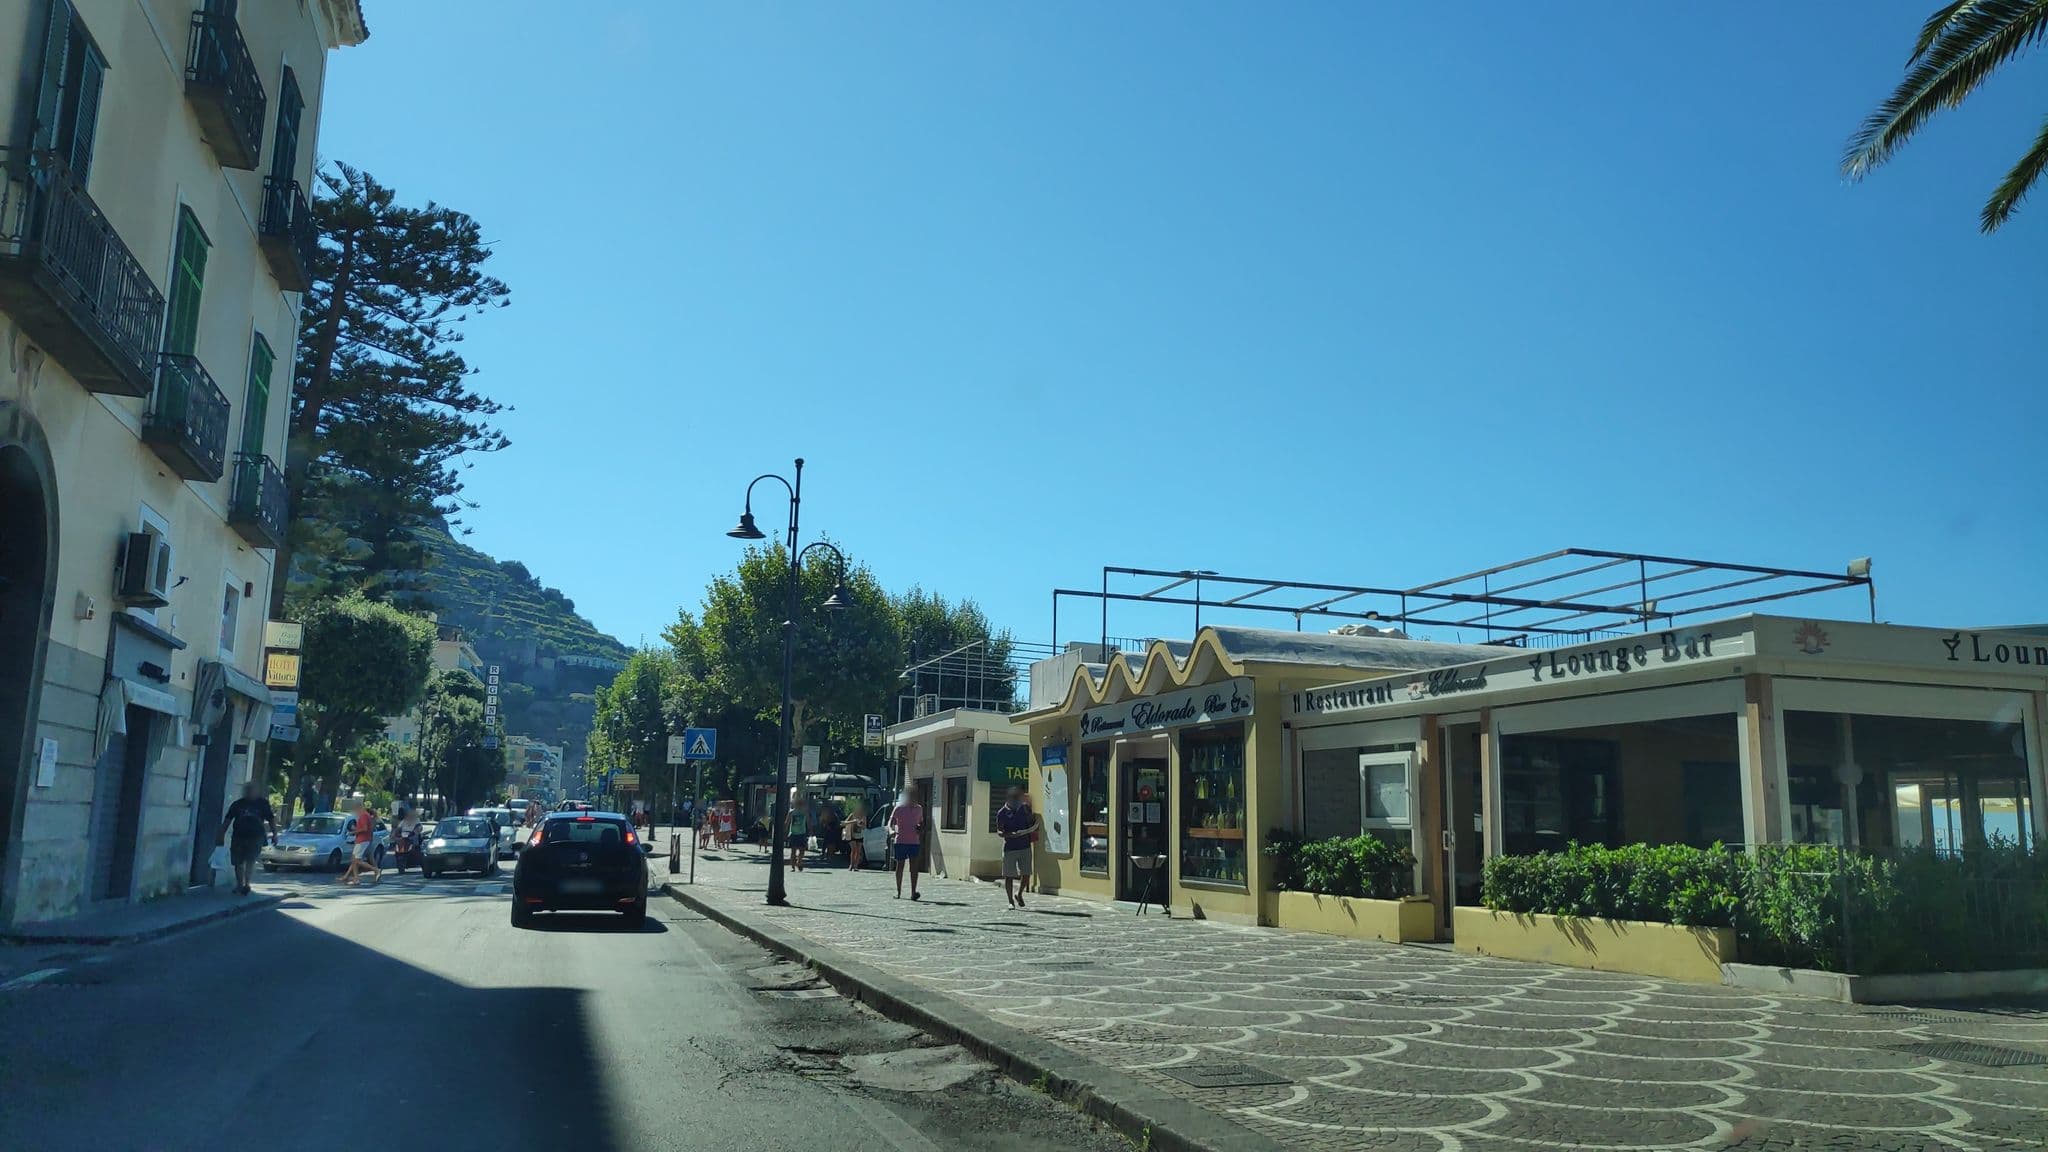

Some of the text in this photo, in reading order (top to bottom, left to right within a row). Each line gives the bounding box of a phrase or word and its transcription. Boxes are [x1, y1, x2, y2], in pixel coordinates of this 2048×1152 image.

[1970, 633, 2048, 665] Loun
[1306, 681, 1394, 711] Restaurant
[1550, 644, 1647, 678] Lounge
[1661, 632, 1714, 662] Bar
[1131, 698, 1197, 728] Eldorado
[1203, 694, 1227, 714] Bar
